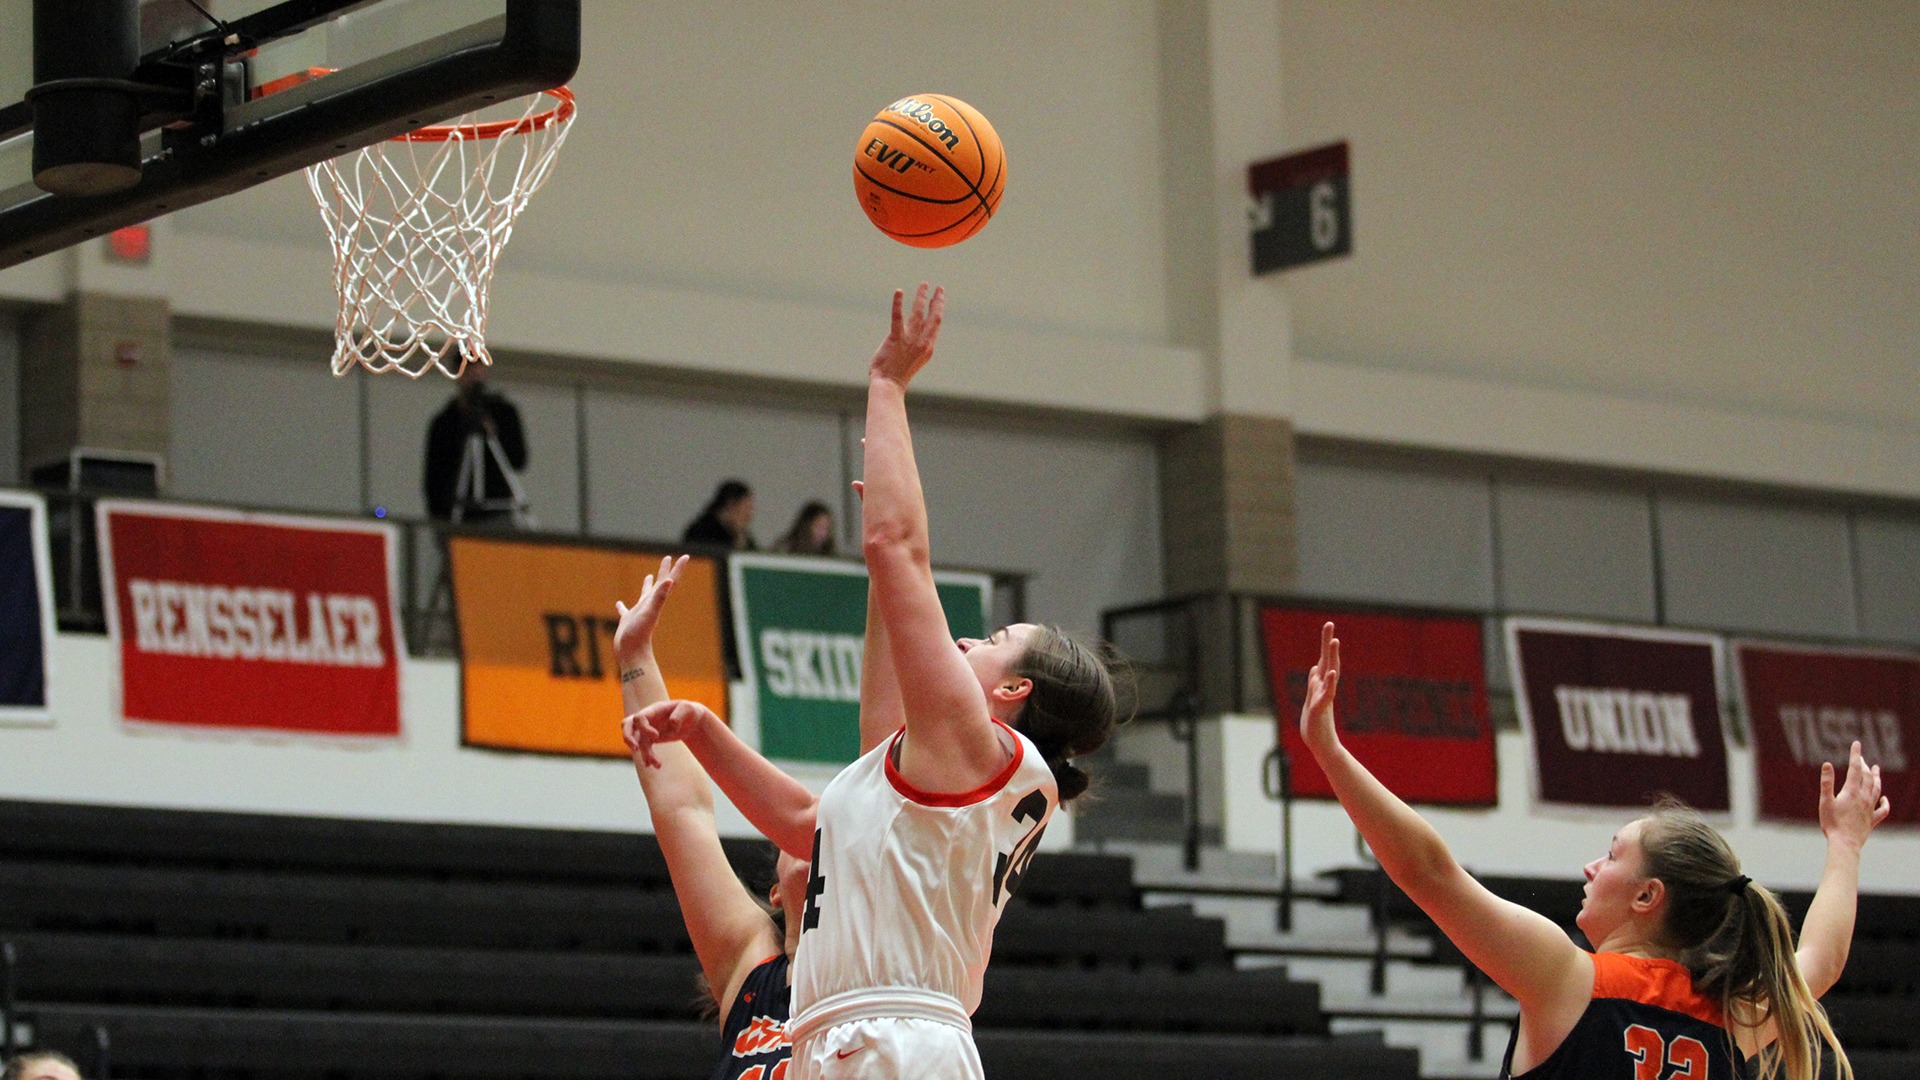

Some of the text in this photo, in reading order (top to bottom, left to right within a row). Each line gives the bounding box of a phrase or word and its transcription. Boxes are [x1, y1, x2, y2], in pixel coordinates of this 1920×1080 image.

[864, 137, 916, 174] EVO
[1308, 181, 1339, 250] 6
[128, 578, 386, 668] RENSSELAER
[761, 628, 865, 701] SKID
[1553, 684, 1699, 758] UNION
[1778, 703, 1907, 769] VASSAR
